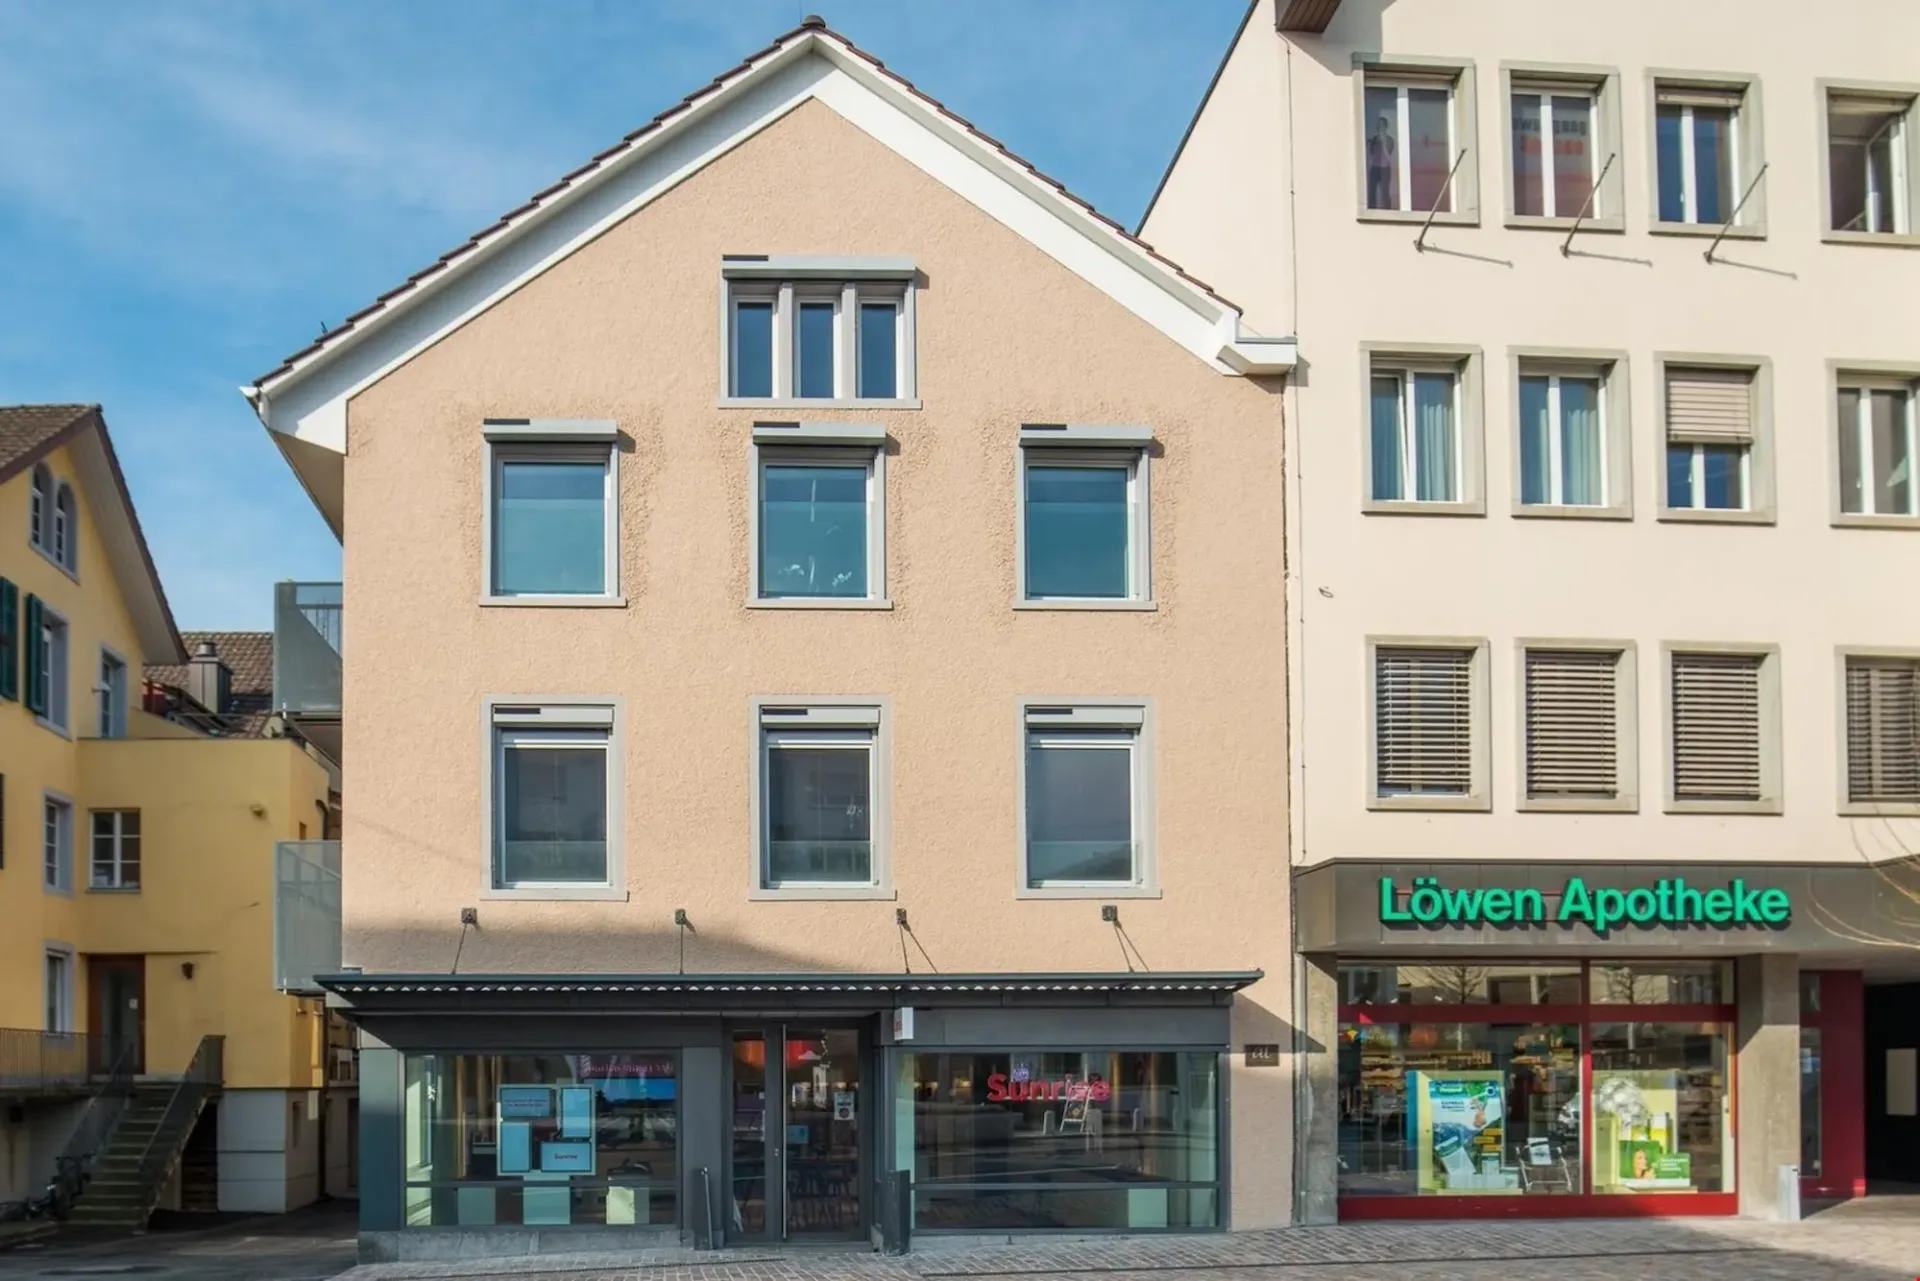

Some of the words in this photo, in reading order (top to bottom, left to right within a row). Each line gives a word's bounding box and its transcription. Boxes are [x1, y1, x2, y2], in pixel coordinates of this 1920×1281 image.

[1380, 876, 1543, 922] Löwen
[1558, 877, 1790, 931] Apotheke
[987, 1072, 1111, 1102] Sunrise
